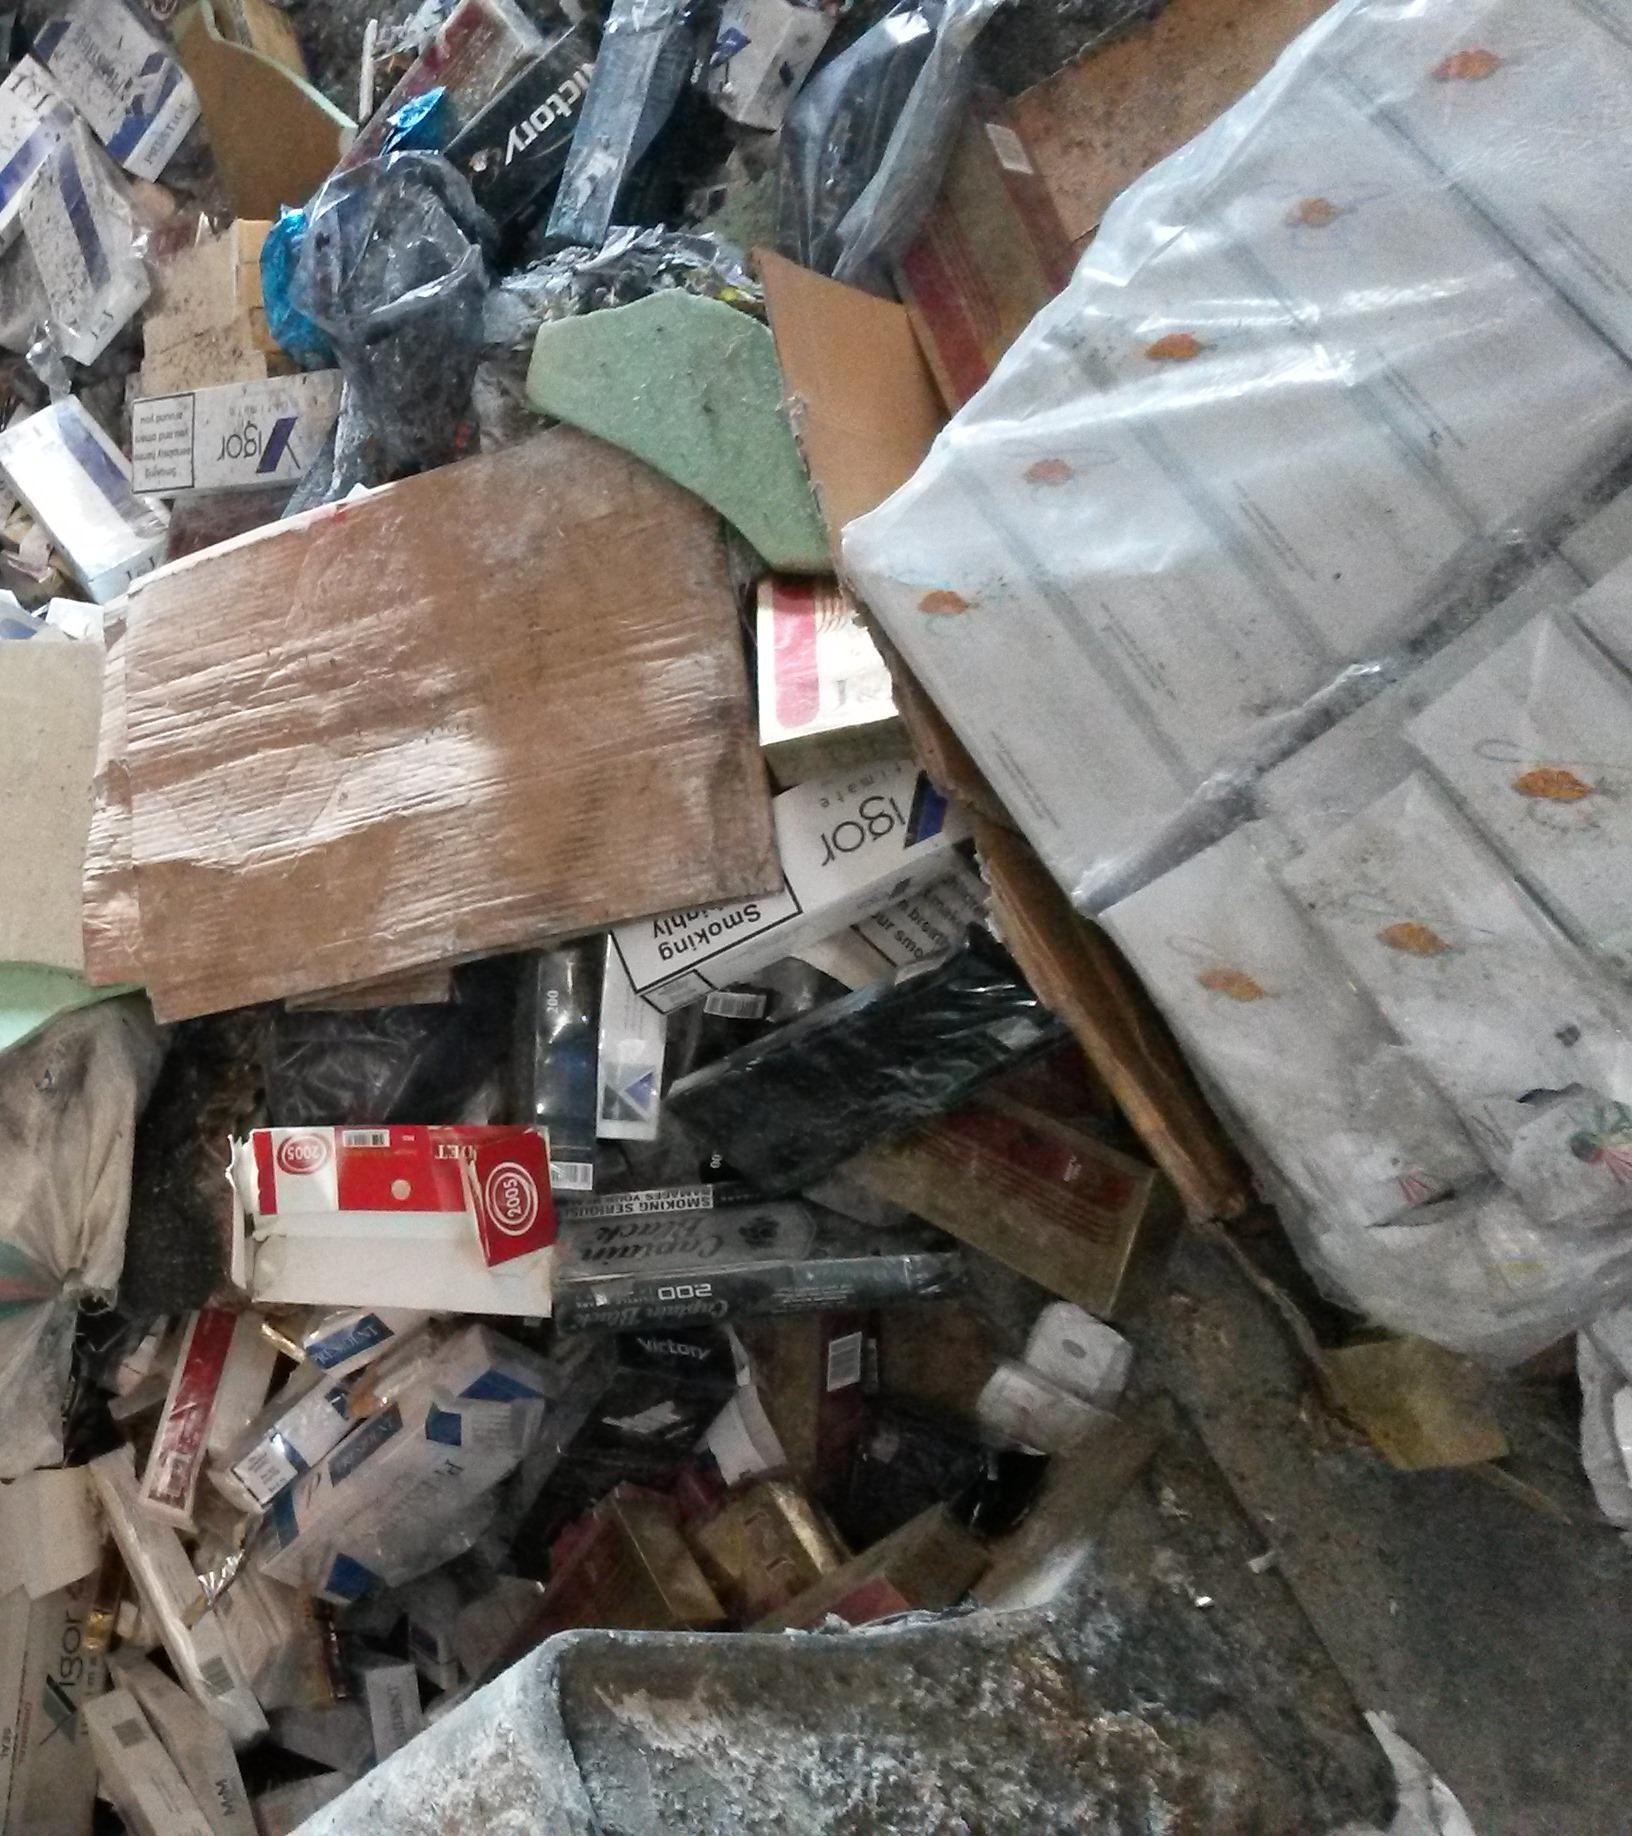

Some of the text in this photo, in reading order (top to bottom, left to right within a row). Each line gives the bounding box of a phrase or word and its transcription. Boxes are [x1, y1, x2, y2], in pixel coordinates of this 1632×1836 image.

[217, 416, 301, 474] Vigor
[659, 903, 762, 962] Smoking
[288, 1145, 319, 1161] 2005
[502, 1178, 522, 1218] 2005
[638, 1197, 712, 1212] SMOKING
[658, 1283, 713, 1301] 200
[40, 1609, 85, 1746] Vigor
